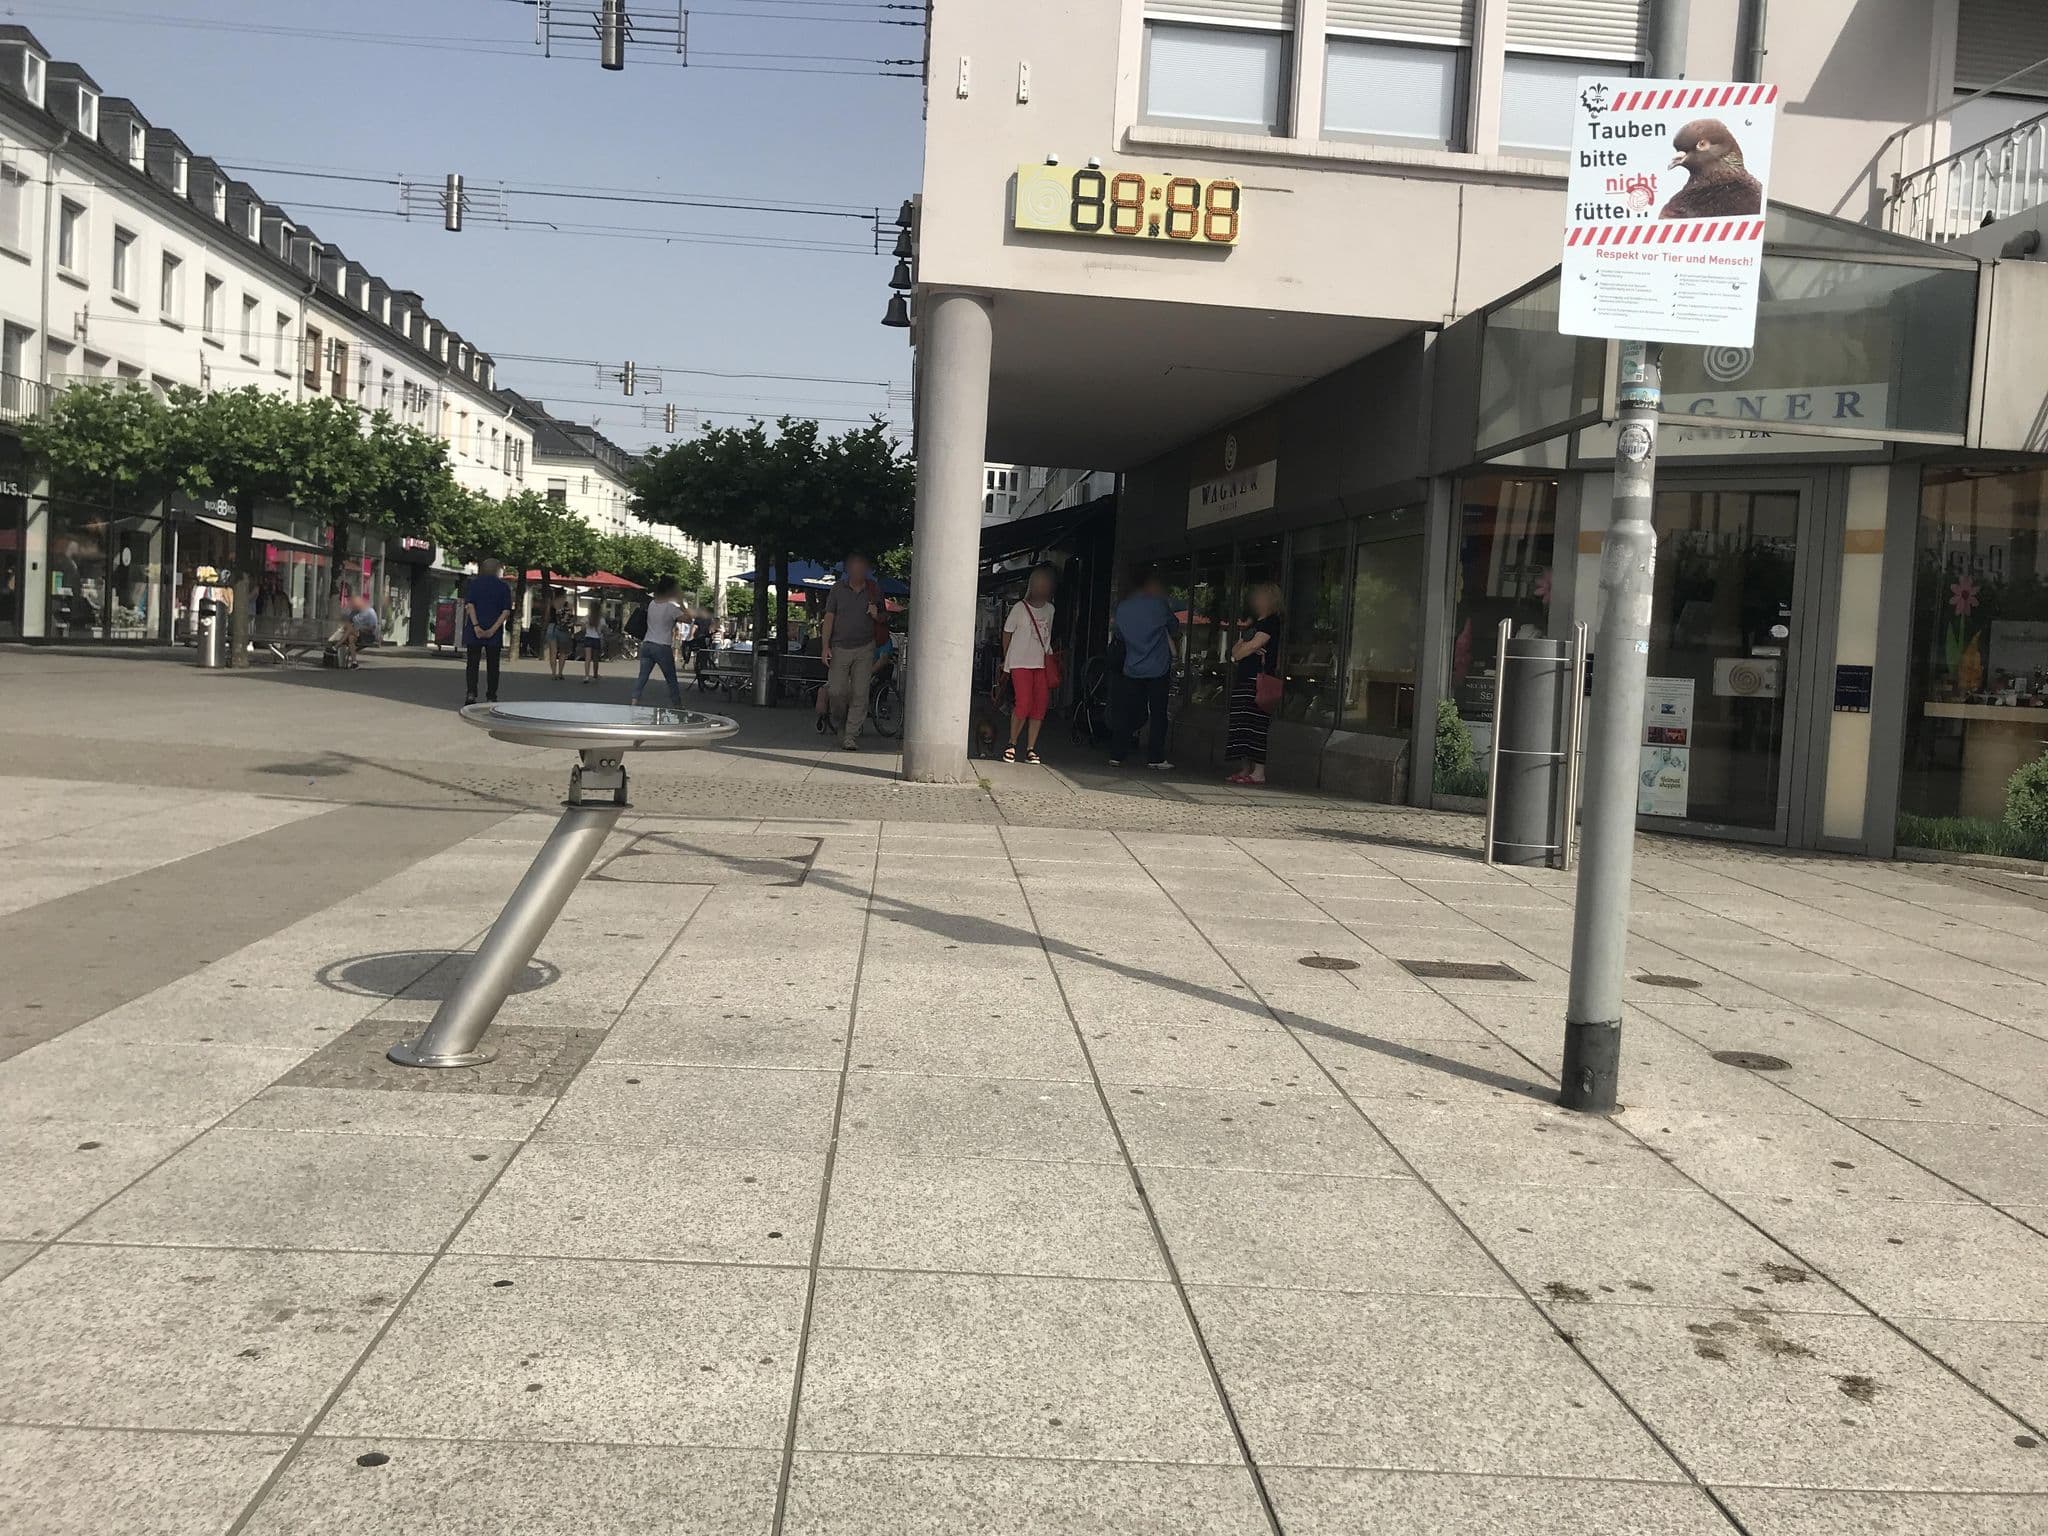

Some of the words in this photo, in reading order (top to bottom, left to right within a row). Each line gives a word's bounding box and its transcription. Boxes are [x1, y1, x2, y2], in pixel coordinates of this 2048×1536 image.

[1588, 121, 1667, 140] Tauben
[1580, 150, 1628, 168] bitte
[1606, 173, 1658, 193] nicht
[1596, 248, 1640, 261] Respekt
[1641, 252, 1660, 261] vor
[1663, 252, 1683, 263] Tier
[1686, 254, 1706, 265] und
[1709, 255, 1754, 267] Mensch!
